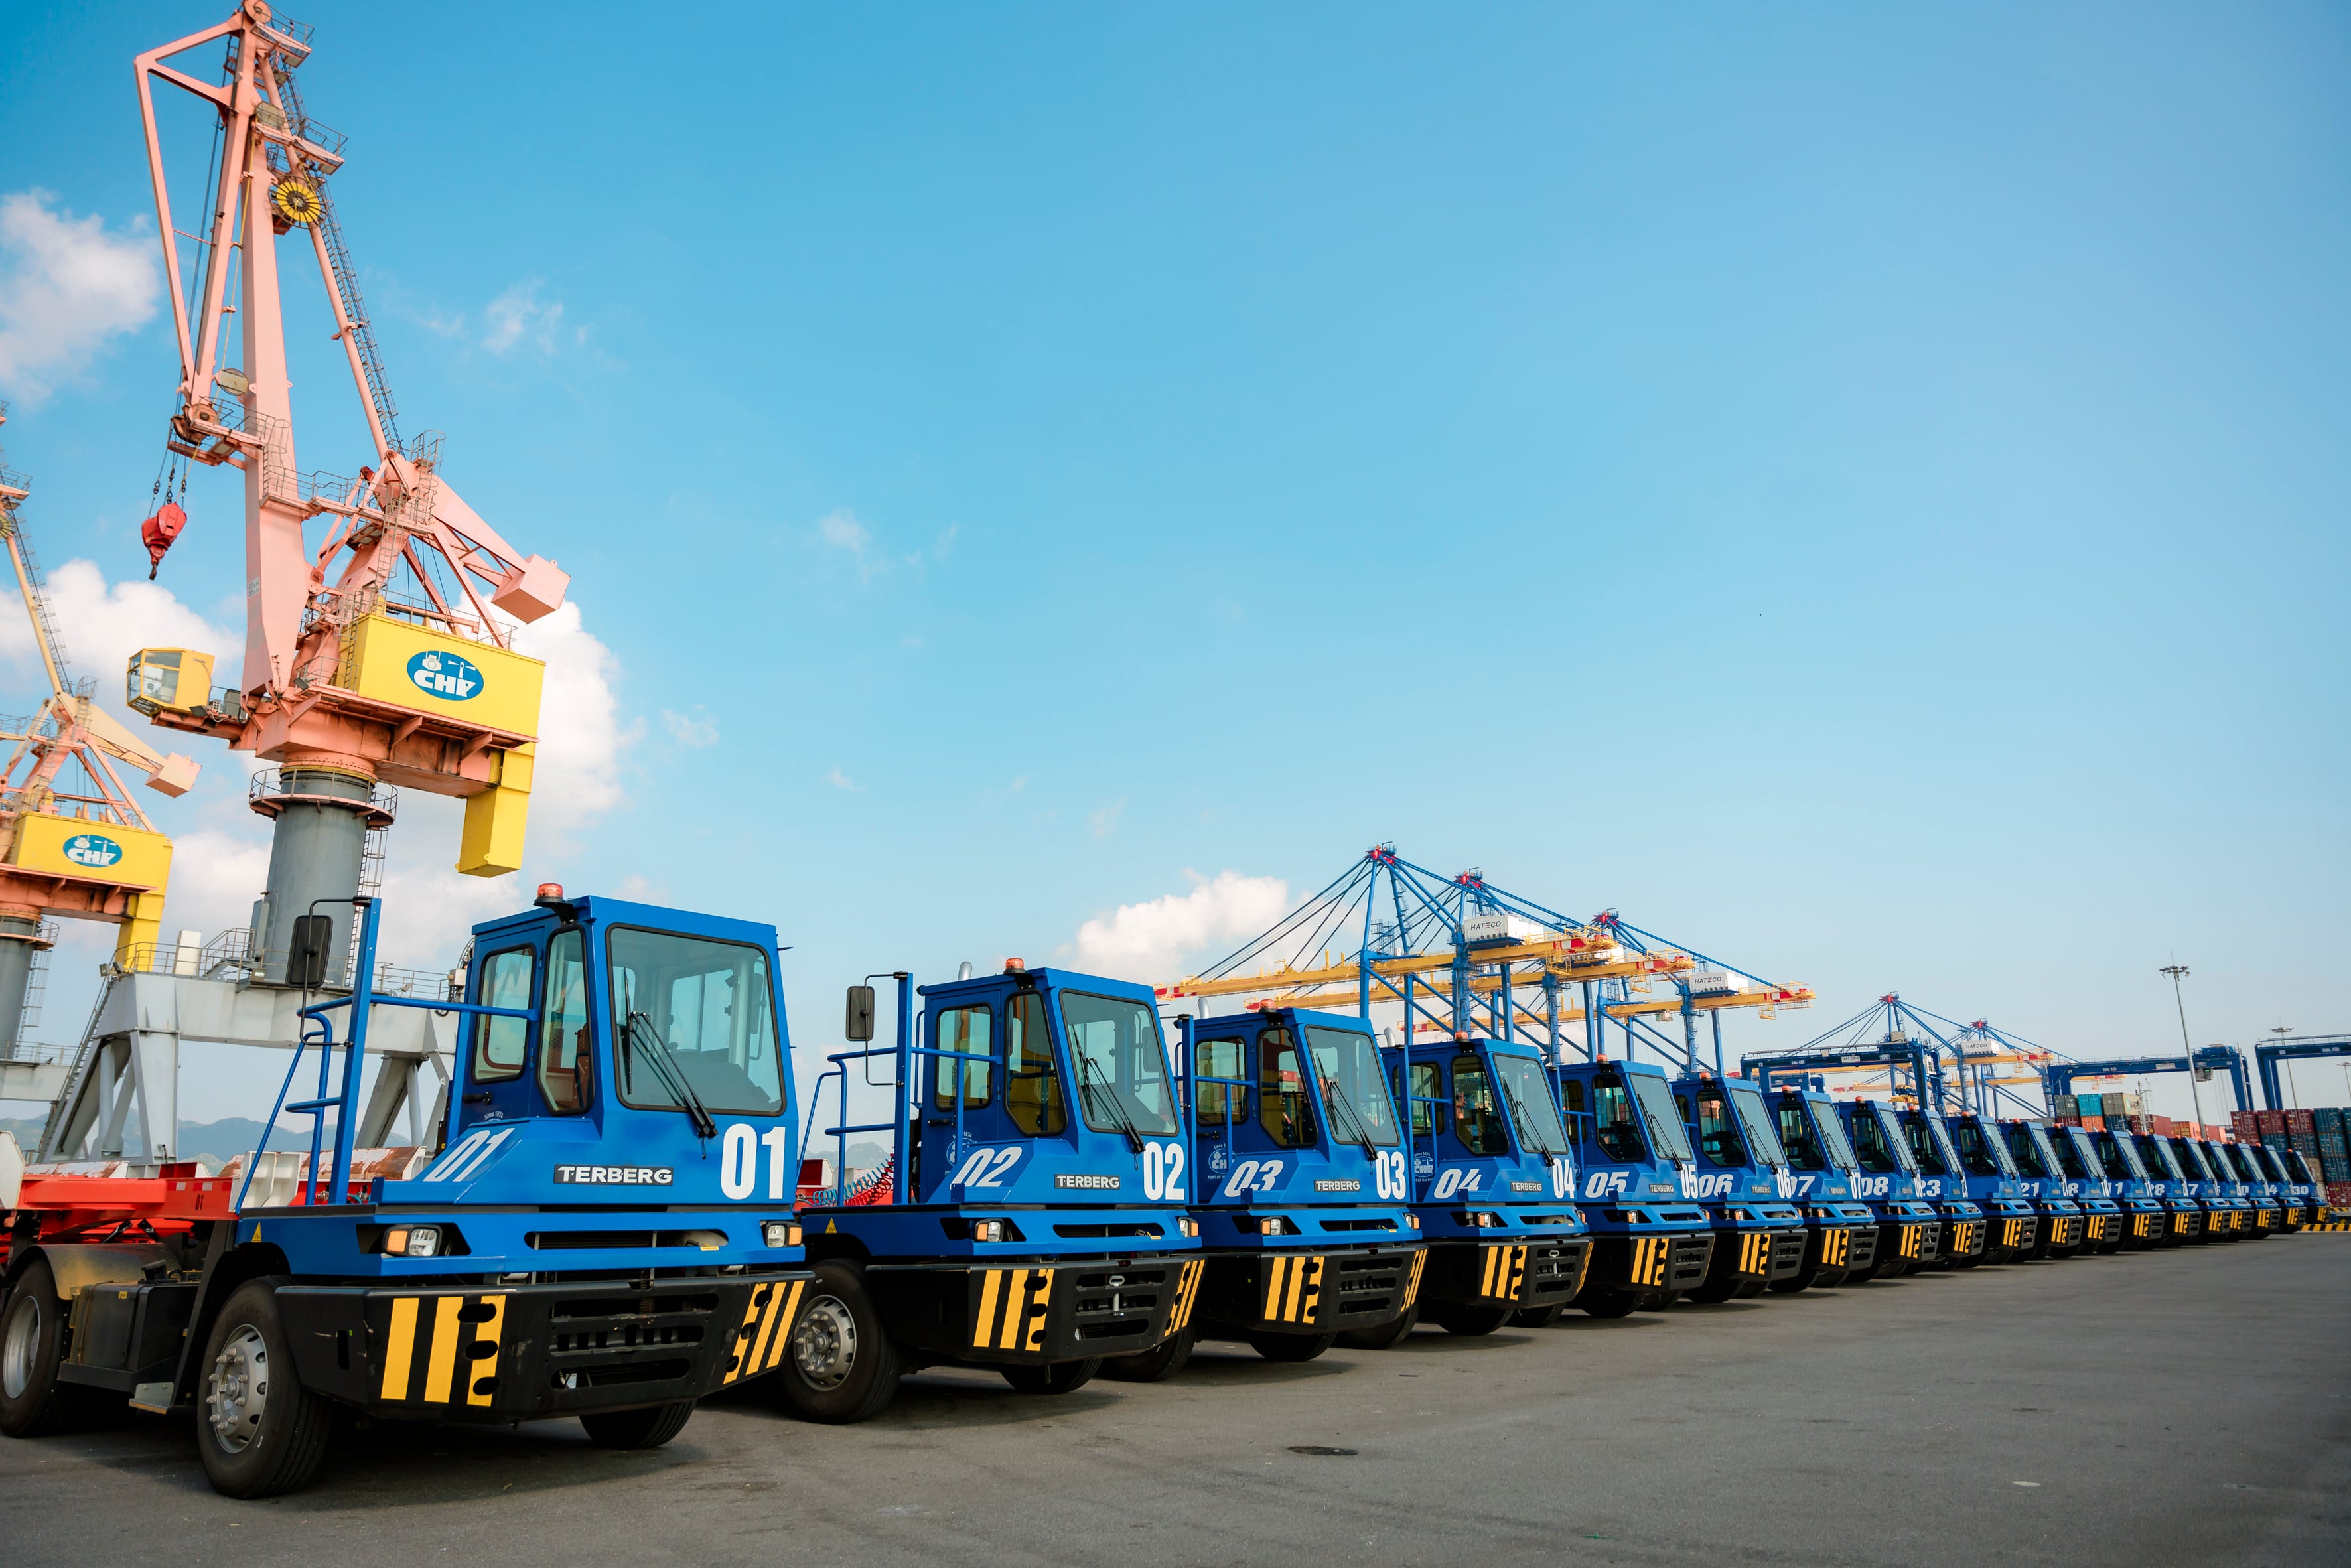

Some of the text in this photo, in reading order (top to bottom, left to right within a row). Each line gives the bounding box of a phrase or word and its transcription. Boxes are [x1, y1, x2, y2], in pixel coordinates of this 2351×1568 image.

[1470, 921, 1502, 931] HATECO
[423, 1128, 515, 1182] 01
[721, 1123, 786, 1200] 01
[950, 1146, 1023, 1190] 02
[558, 1166, 672, 1184] TERBERG
[1056, 1175, 1120, 1188] TERBERG
[1143, 1141, 1185, 1200] 02
[1224, 1160, 1284, 1197] 03
[1376, 1151, 1406, 1200] 03
[1434, 1169, 1482, 1199] 04
[1553, 1158, 1575, 1199] 04
[1585, 1171, 1630, 1198] 05
[1681, 1163, 1699, 1199] 05
[1776, 1168, 1792, 1199] 06
[1316, 1181, 1360, 1191] TERBERG
[1511, 1182, 1542, 1191] TERBERG
[1699, 1174, 1734, 1198] 06
[2021, 1182, 2040, 1197] 21
[195, 1194, 204, 1211] 01
